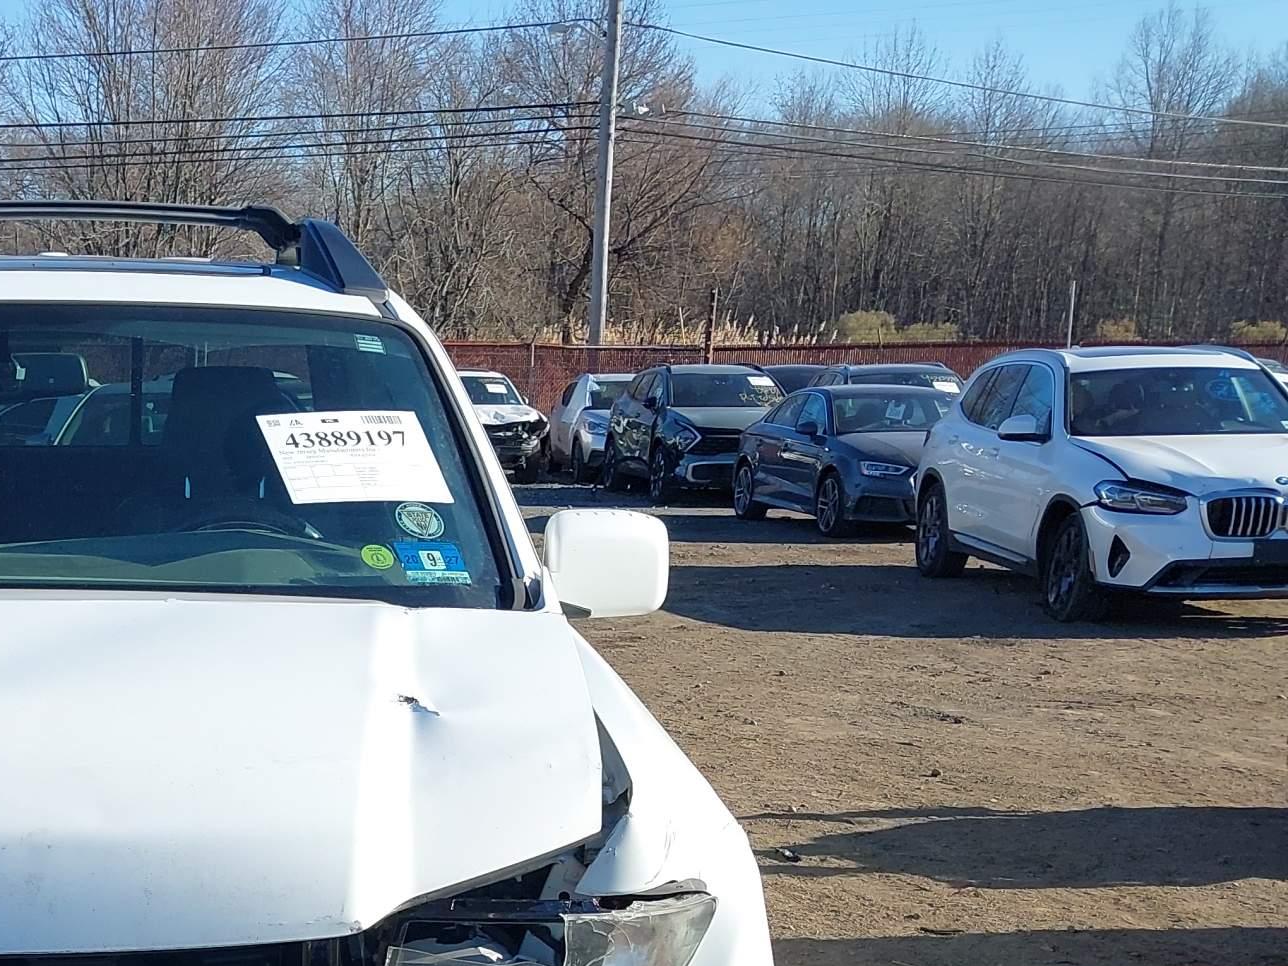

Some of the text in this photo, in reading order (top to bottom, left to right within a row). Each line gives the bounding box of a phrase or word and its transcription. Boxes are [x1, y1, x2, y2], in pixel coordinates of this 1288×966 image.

[285, 430, 405, 448] 43889197
[404, 552, 459, 567] 20 9 27
